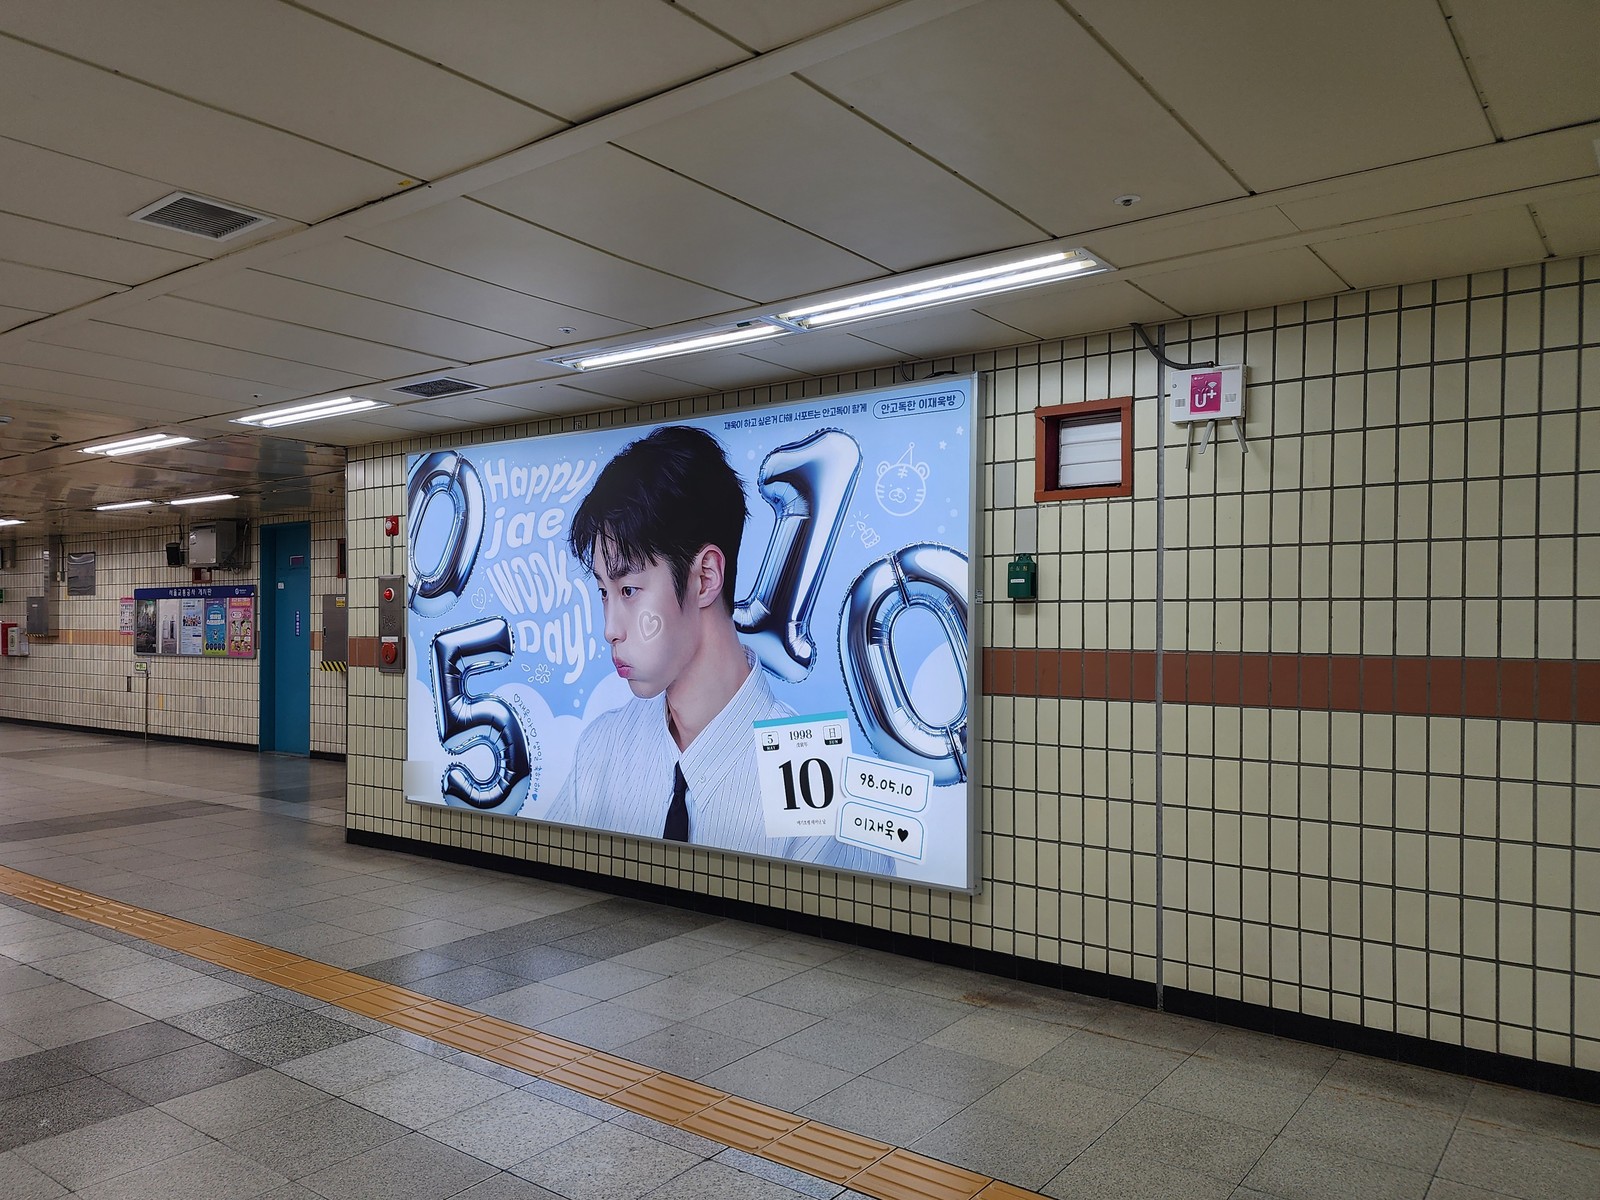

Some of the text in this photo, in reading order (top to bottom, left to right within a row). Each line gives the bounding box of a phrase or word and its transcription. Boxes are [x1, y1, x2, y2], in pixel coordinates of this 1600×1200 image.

[880, 394, 957, 415] 안고독한 이재욱방
[724, 419, 743, 430] 재욱이
[743, 417, 757, 428] 하고
[778, 413, 793, 423] 다해
[793, 409, 821, 422] 서포트는
[821, 406, 851, 418] 안고독이
[484, 458, 597, 504] Happy
[484, 506, 565, 560] jae
[767, 734, 774, 744] 5
[789, 729, 813, 740] 1998
[779, 758, 834, 810] 10
[860, 773, 913, 796] 98.05.10
